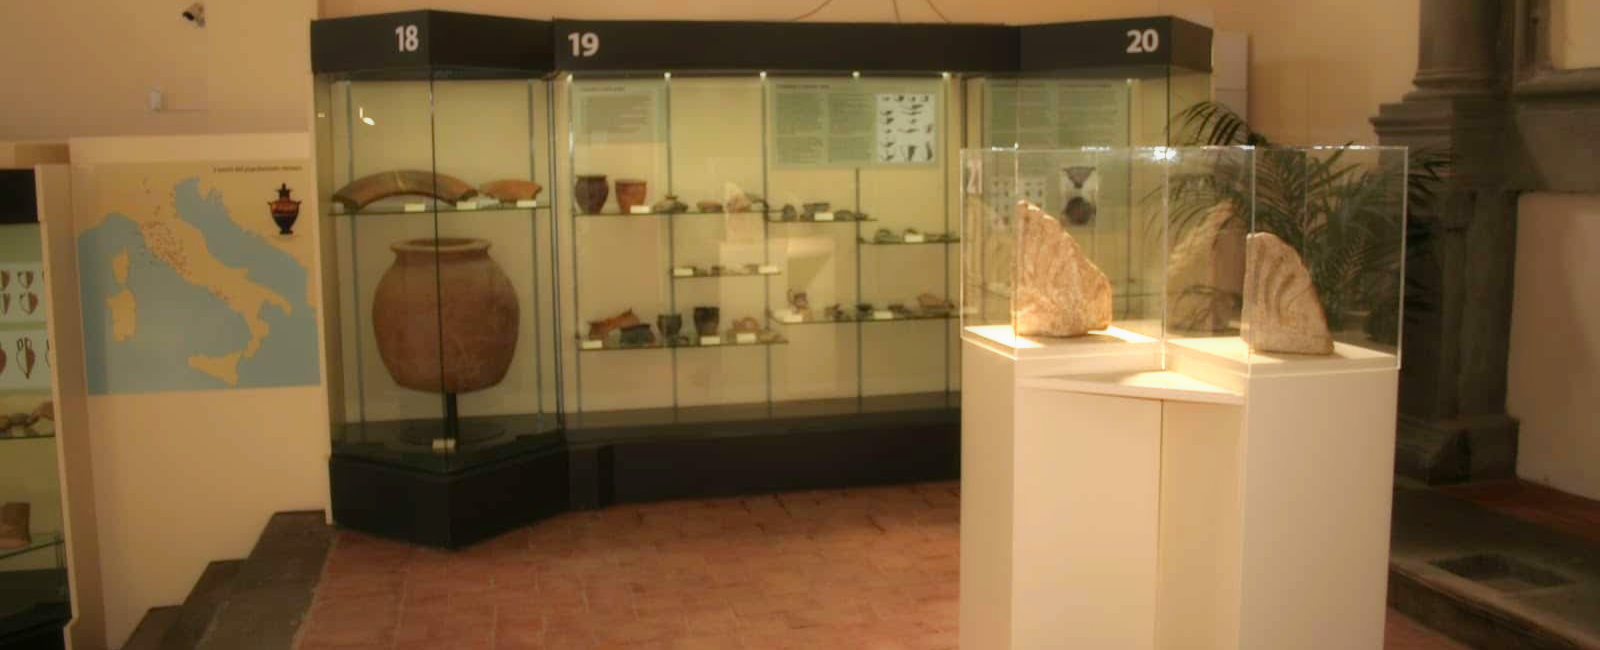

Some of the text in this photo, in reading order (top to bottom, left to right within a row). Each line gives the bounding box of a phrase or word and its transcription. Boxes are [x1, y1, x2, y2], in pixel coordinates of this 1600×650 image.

[395, 25, 419, 52] 18
[567, 32, 600, 57] 19
[1126, 28, 1159, 54] 20
